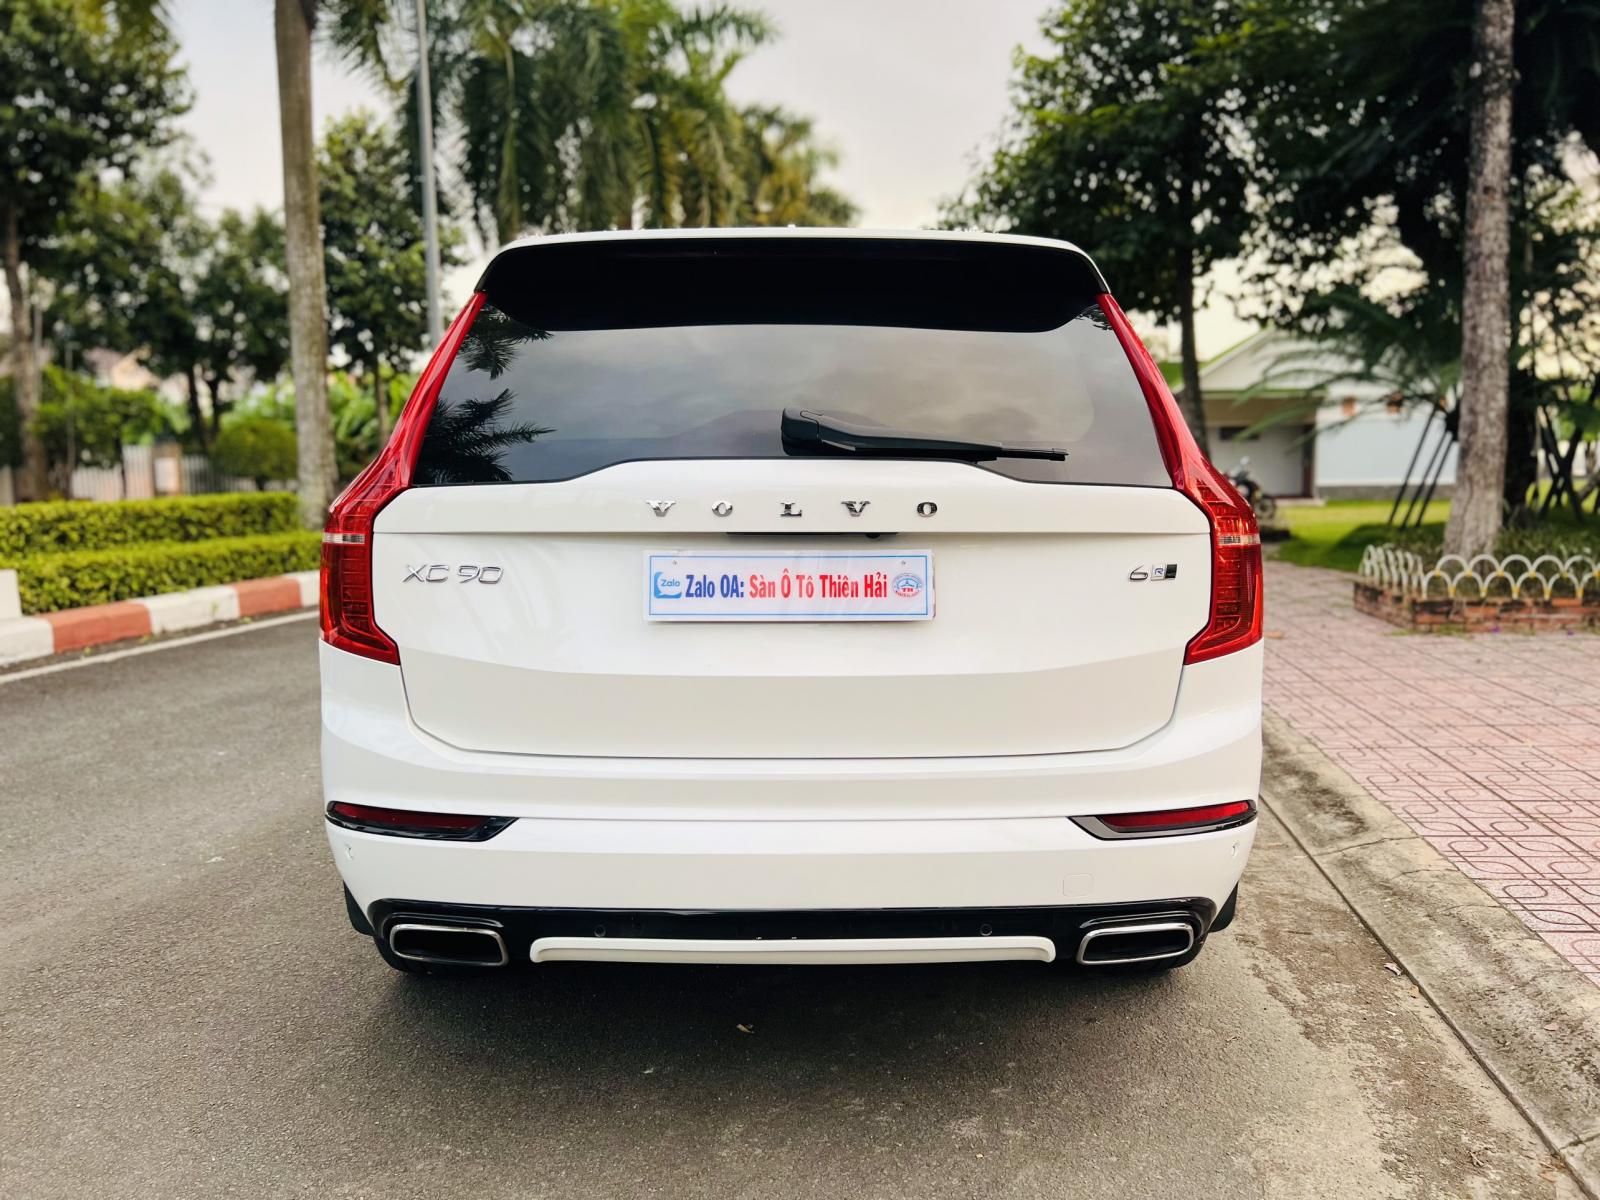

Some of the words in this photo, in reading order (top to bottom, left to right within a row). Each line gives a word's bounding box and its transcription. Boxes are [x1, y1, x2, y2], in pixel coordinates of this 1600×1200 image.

[646, 500, 938, 518] VOLVO
[403, 564, 449, 583] XC
[458, 565, 504, 584] 90
[660, 578, 681, 587] Zalo
[685, 574, 716, 598] Zalo
[720, 574, 745, 598] OA:
[749, 574, 776, 598] Sàn
[780, 568, 792, 598] Ô
[796, 574, 814, 598] Tô
[819, 574, 859, 598] Thiên
[864, 571, 888, 598] Hải
